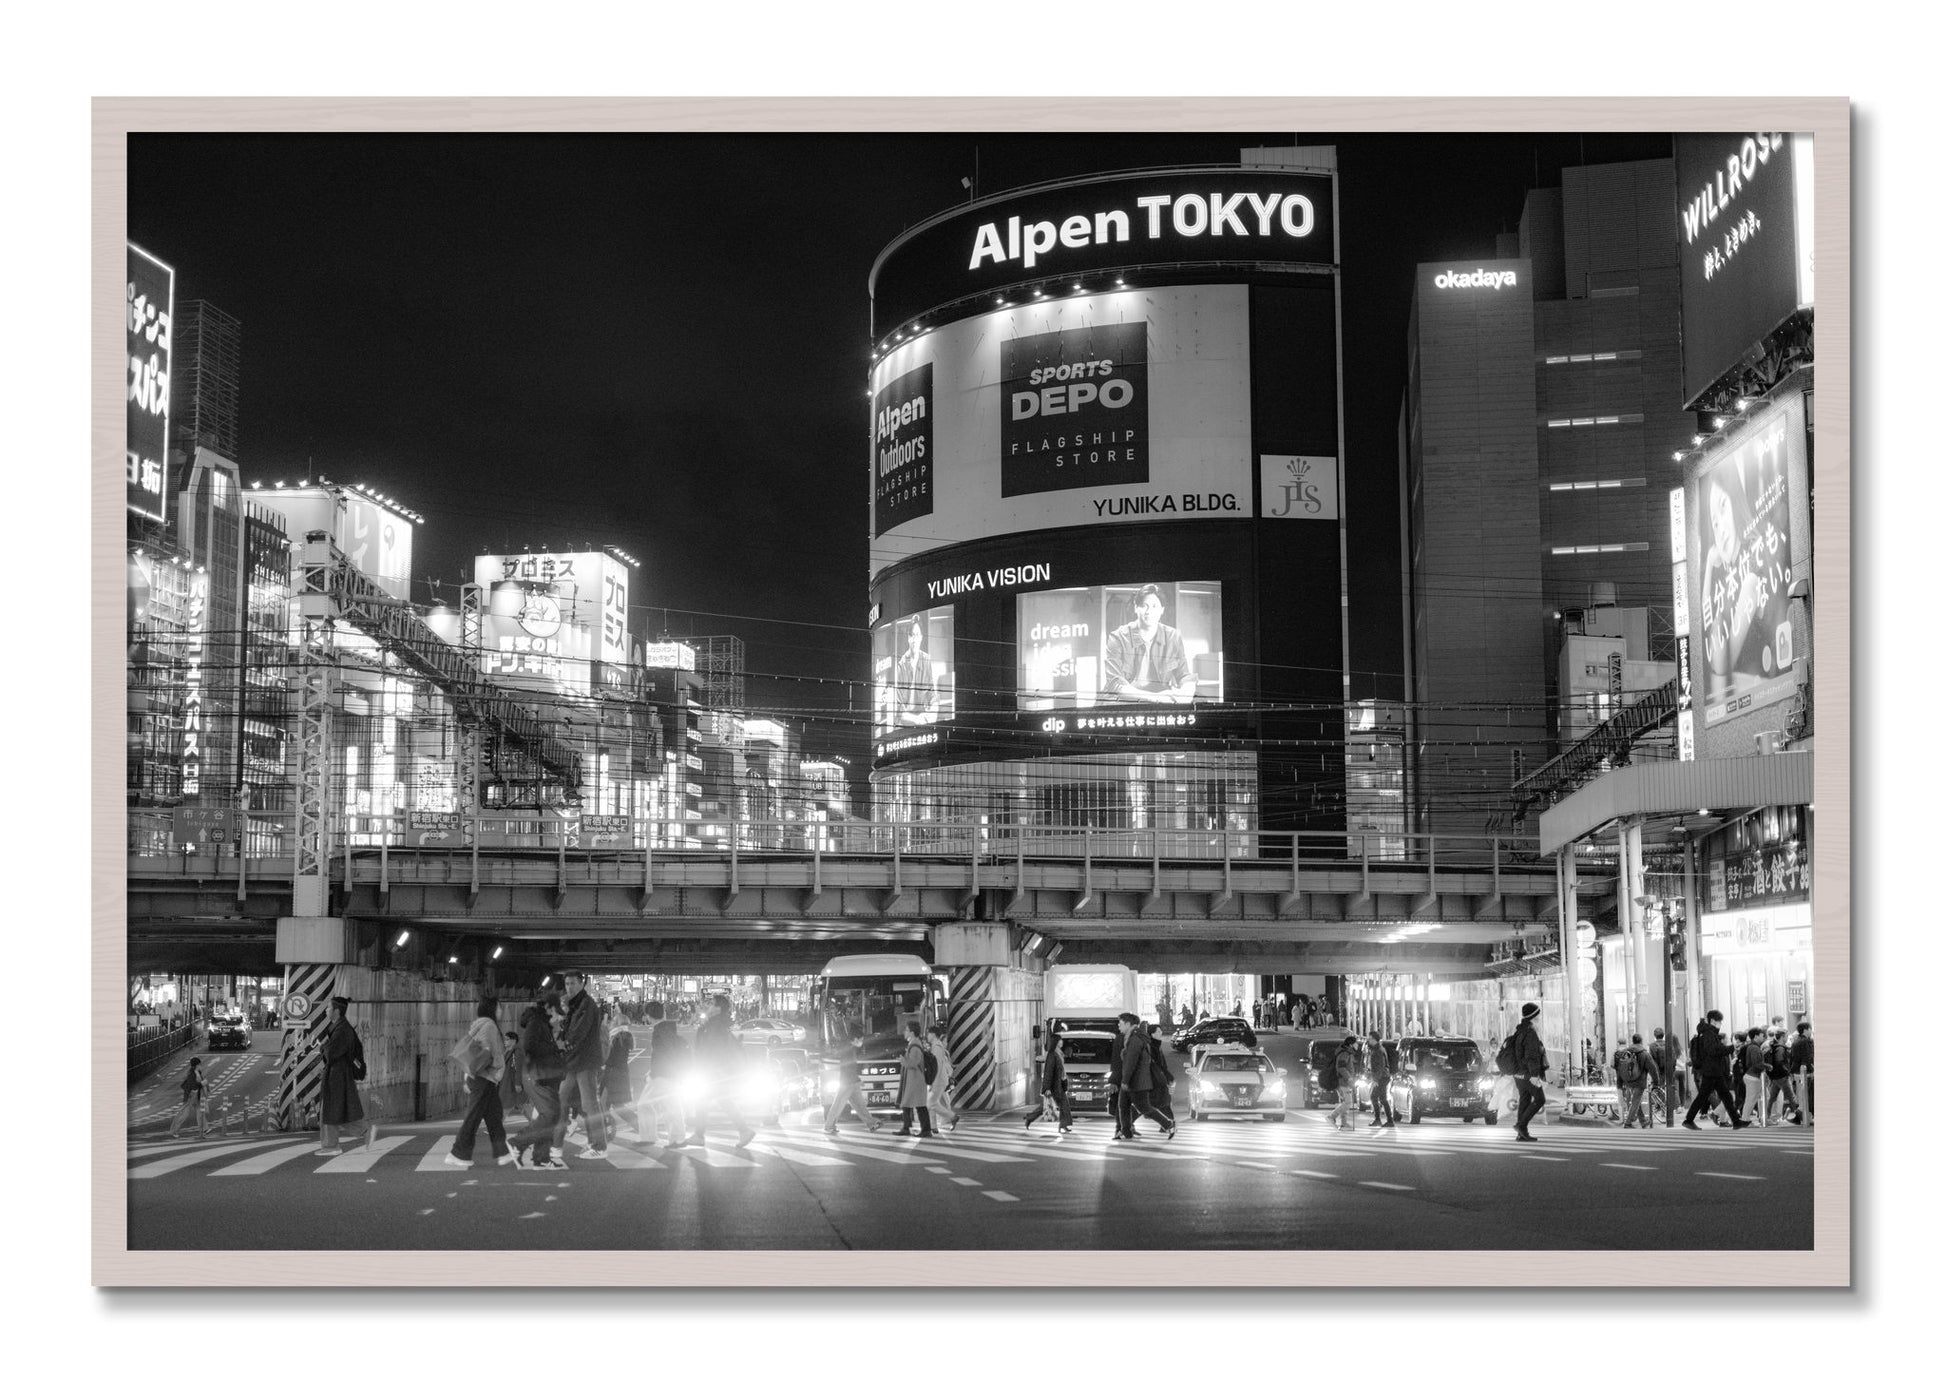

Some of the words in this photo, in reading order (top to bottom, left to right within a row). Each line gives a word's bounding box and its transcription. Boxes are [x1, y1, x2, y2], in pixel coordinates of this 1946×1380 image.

[969, 207, 1130, 270] Alpen
[1138, 193, 1314, 239] TOKYO
[1434, 267, 1517, 290] okadaya
[1029, 358, 1113, 386] SPORTS
[1012, 378, 1134, 421] DEPO
[877, 396, 926, 444] Alpen
[1011, 429, 1136, 455] FLAGSHIP
[880, 435, 925, 478] Outdoors
[1056, 447, 1136, 468] STORE
[876, 465, 927, 500] FLAGSHIP
[890, 482, 927, 507] STORE
[1093, 494, 1178, 517] YUNIKA
[1182, 492, 1241, 513] BLDG.
[254, 563, 286, 586] SHISHA
[502, 558, 576, 579] プロミス
[927, 568, 985, 600] YUNIKA
[987, 562, 1051, 589] VISION
[1030, 623, 1089, 641] dream
[1042, 717, 1066, 733] dip
